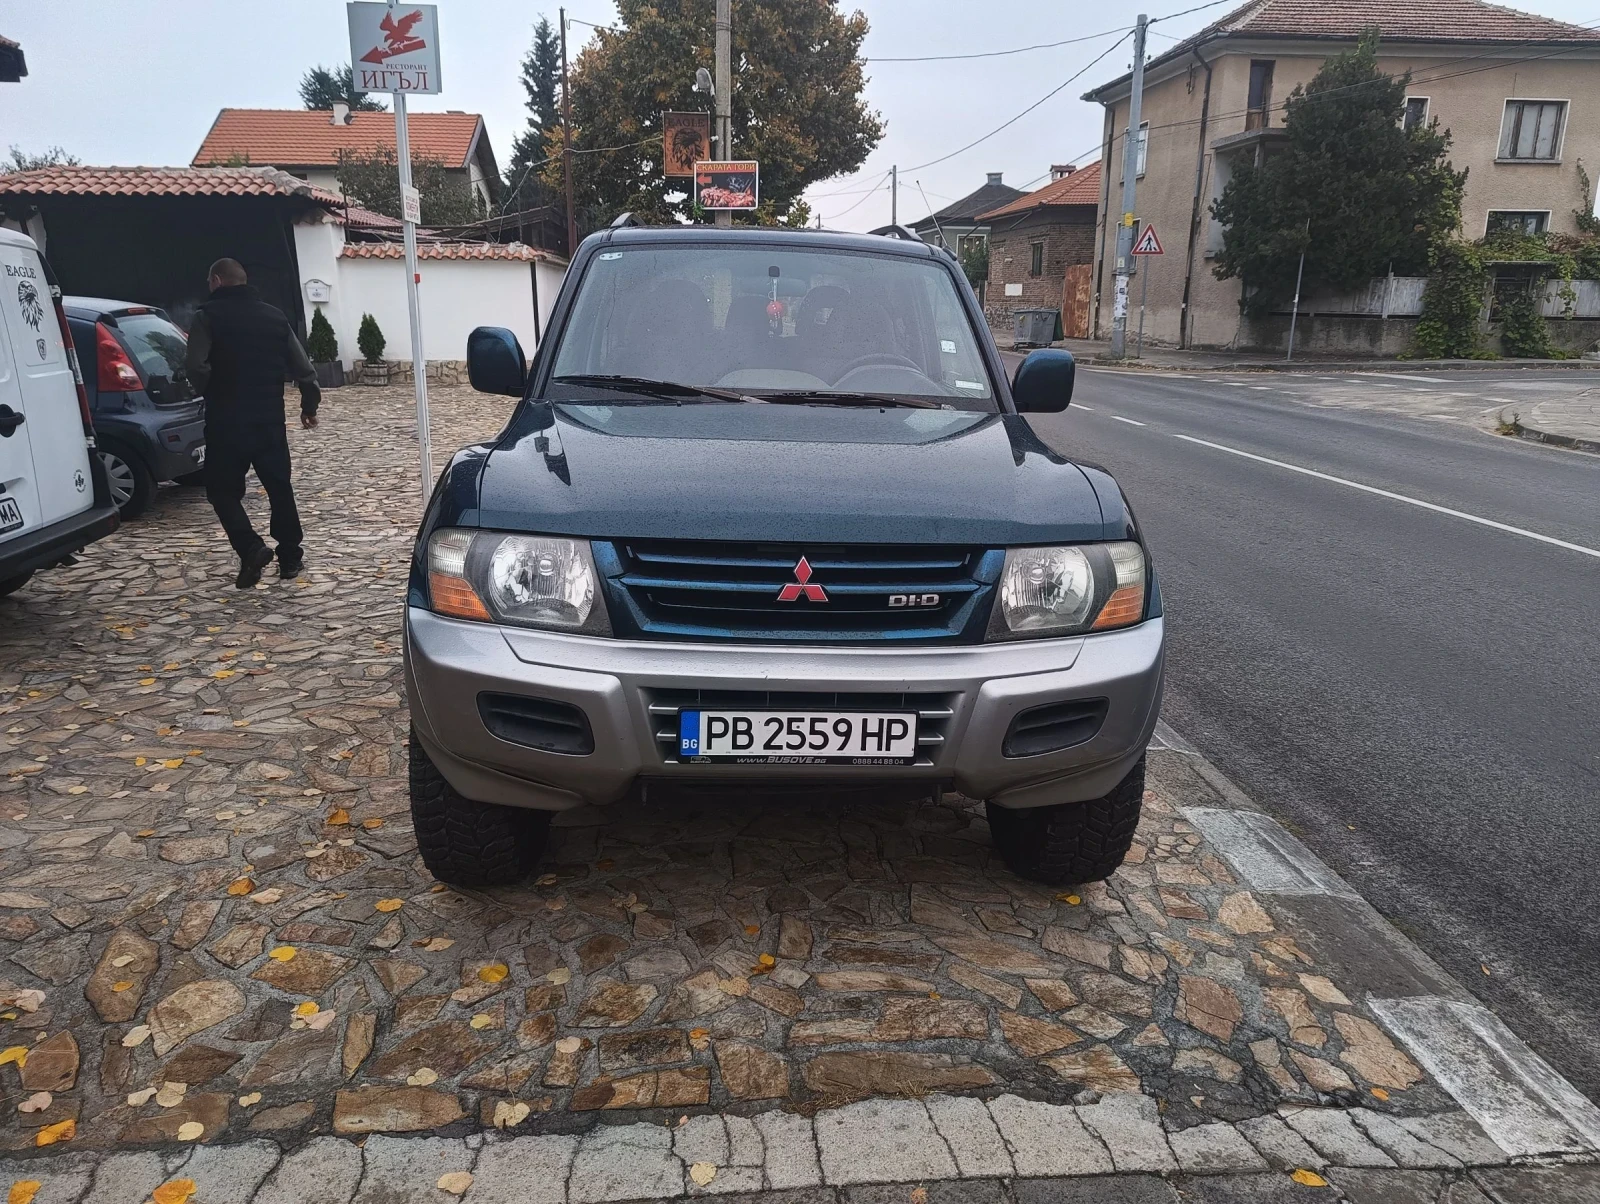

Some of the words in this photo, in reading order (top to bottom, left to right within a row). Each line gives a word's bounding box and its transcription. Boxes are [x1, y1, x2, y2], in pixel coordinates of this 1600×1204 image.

[386, 63, 427, 71] РЕСТОРАНТ
[361, 70, 429, 90] ИГЪЛ
[668, 118, 705, 128] EAGLE
[696, 163, 732, 172] СКАРАТА
[734, 163, 755, 171] ГОРИ
[5, 265, 36, 278] EAGLE
[682, 739, 698, 749] BG
[706, 716, 754, 750] PB
[763, 717, 853, 751] 2559
[860, 718, 909, 751] HP
[737, 756, 827, 764] www.BUSOVE.BG
